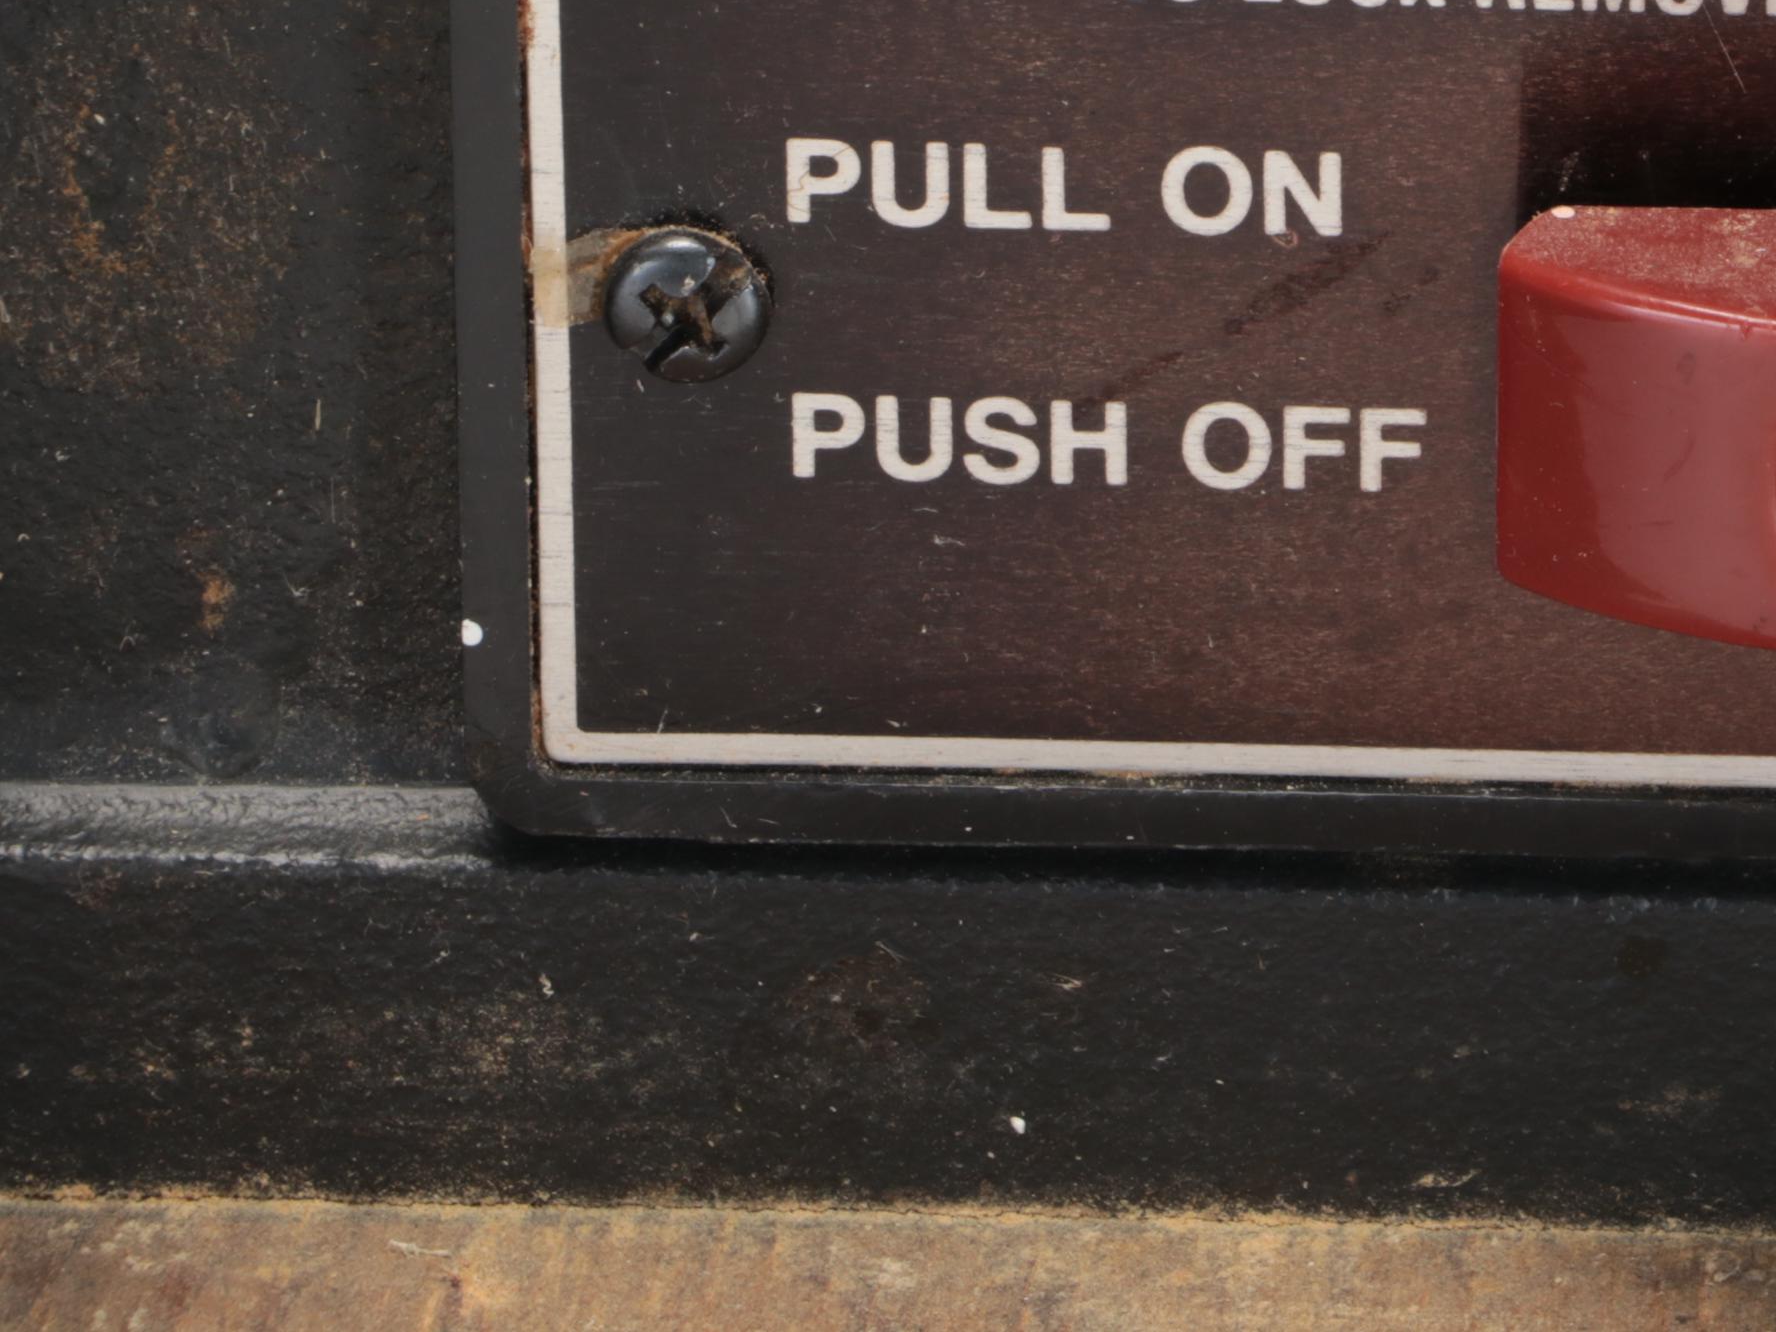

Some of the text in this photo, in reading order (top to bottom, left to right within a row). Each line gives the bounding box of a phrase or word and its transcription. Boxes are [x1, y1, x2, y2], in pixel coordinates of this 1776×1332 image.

[786, 138, 1342, 237] PULL ON
[791, 392, 1427, 492] PUSH OFF
